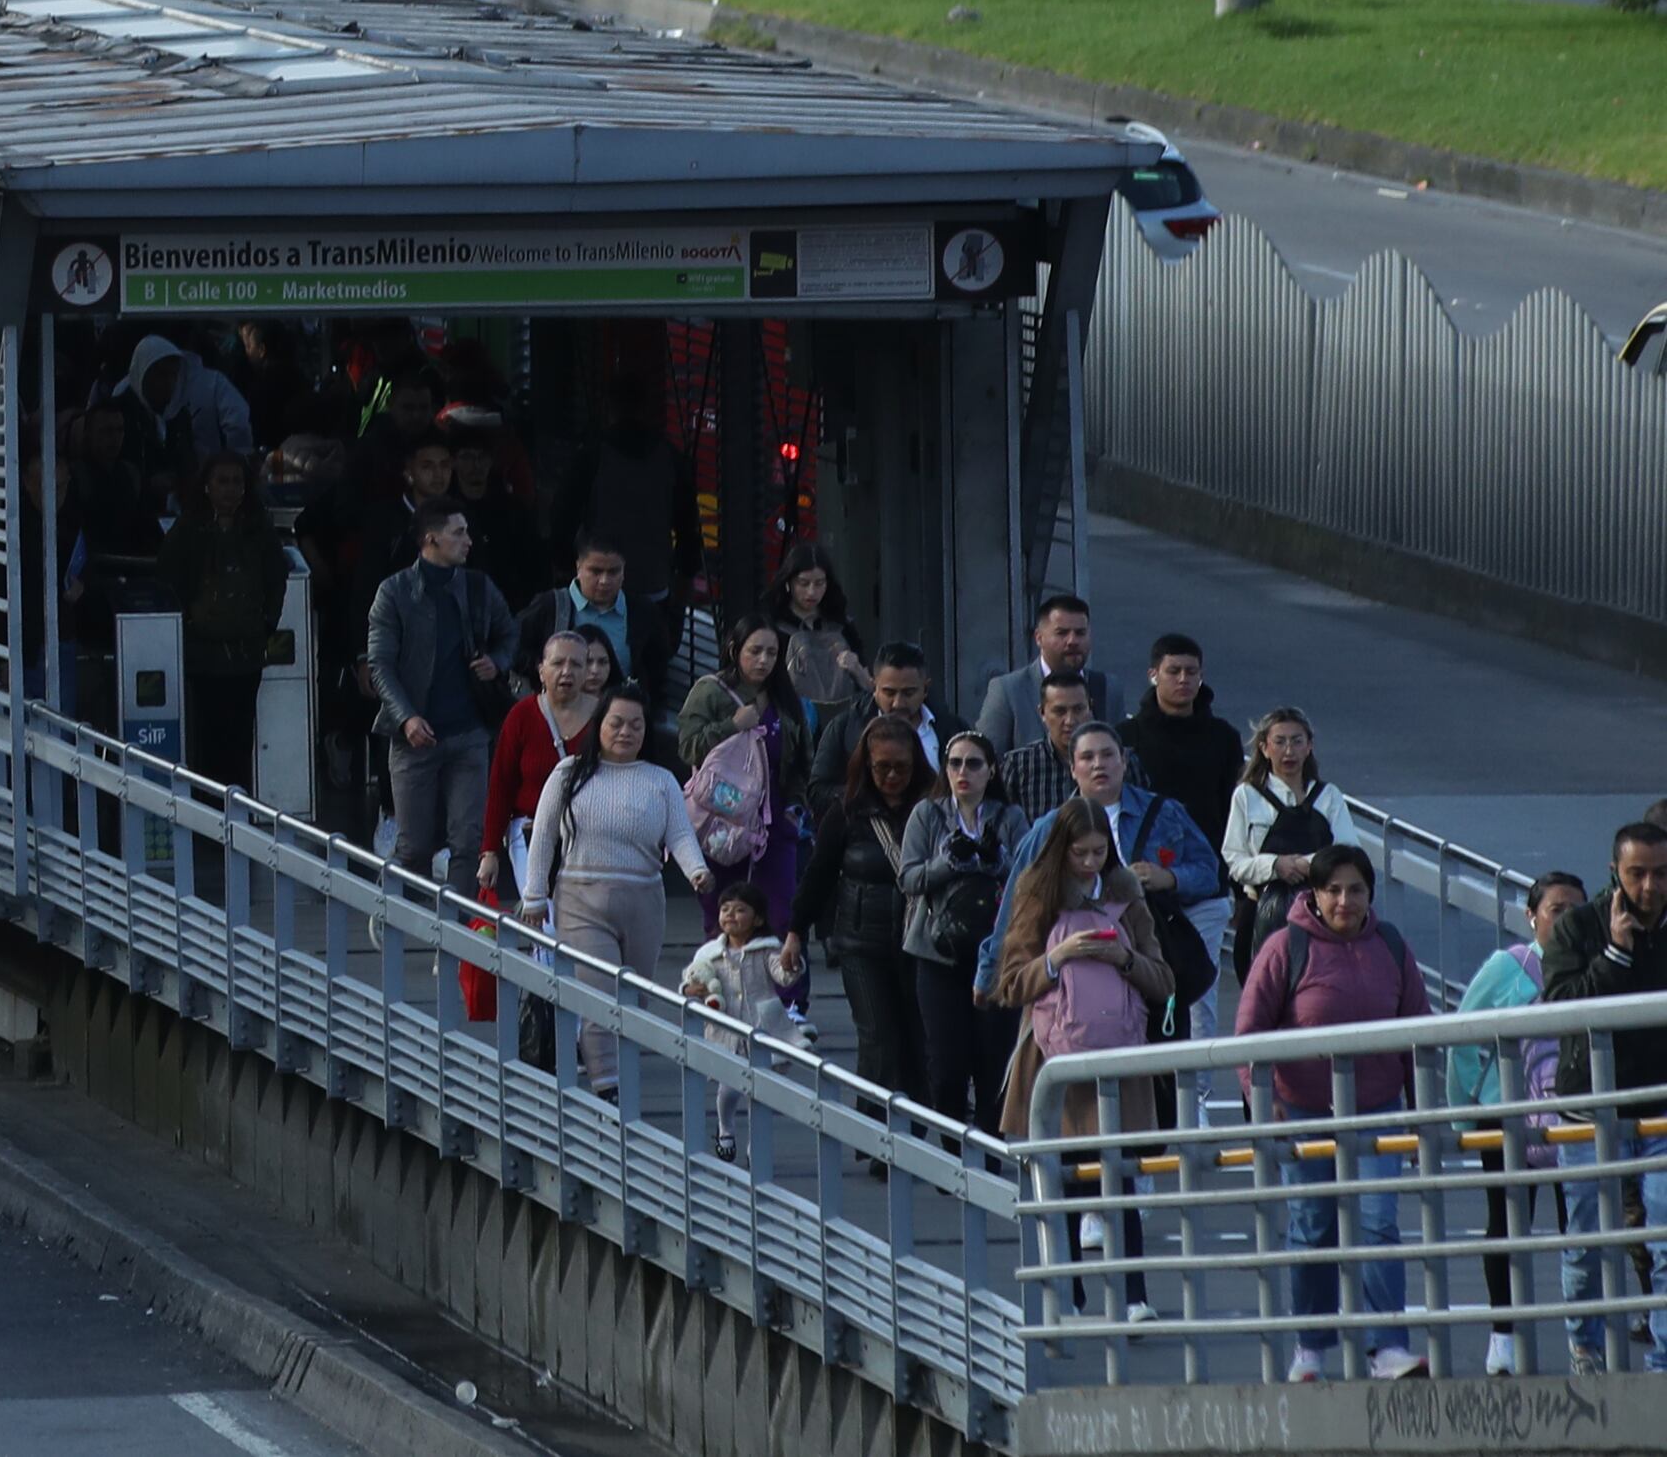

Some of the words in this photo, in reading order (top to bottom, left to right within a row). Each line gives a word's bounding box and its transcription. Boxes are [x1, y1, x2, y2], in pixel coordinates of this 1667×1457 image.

[124, 241, 280, 270] Bienvenidos
[286, 248, 301, 267] a
[554, 246, 572, 262] to
[575, 240, 674, 262] TransMilenio
[144, 282, 155, 300] B
[178, 279, 220, 300] Calle
[225, 280, 257, 300] 100
[282, 280, 407, 301] Marketmedios
